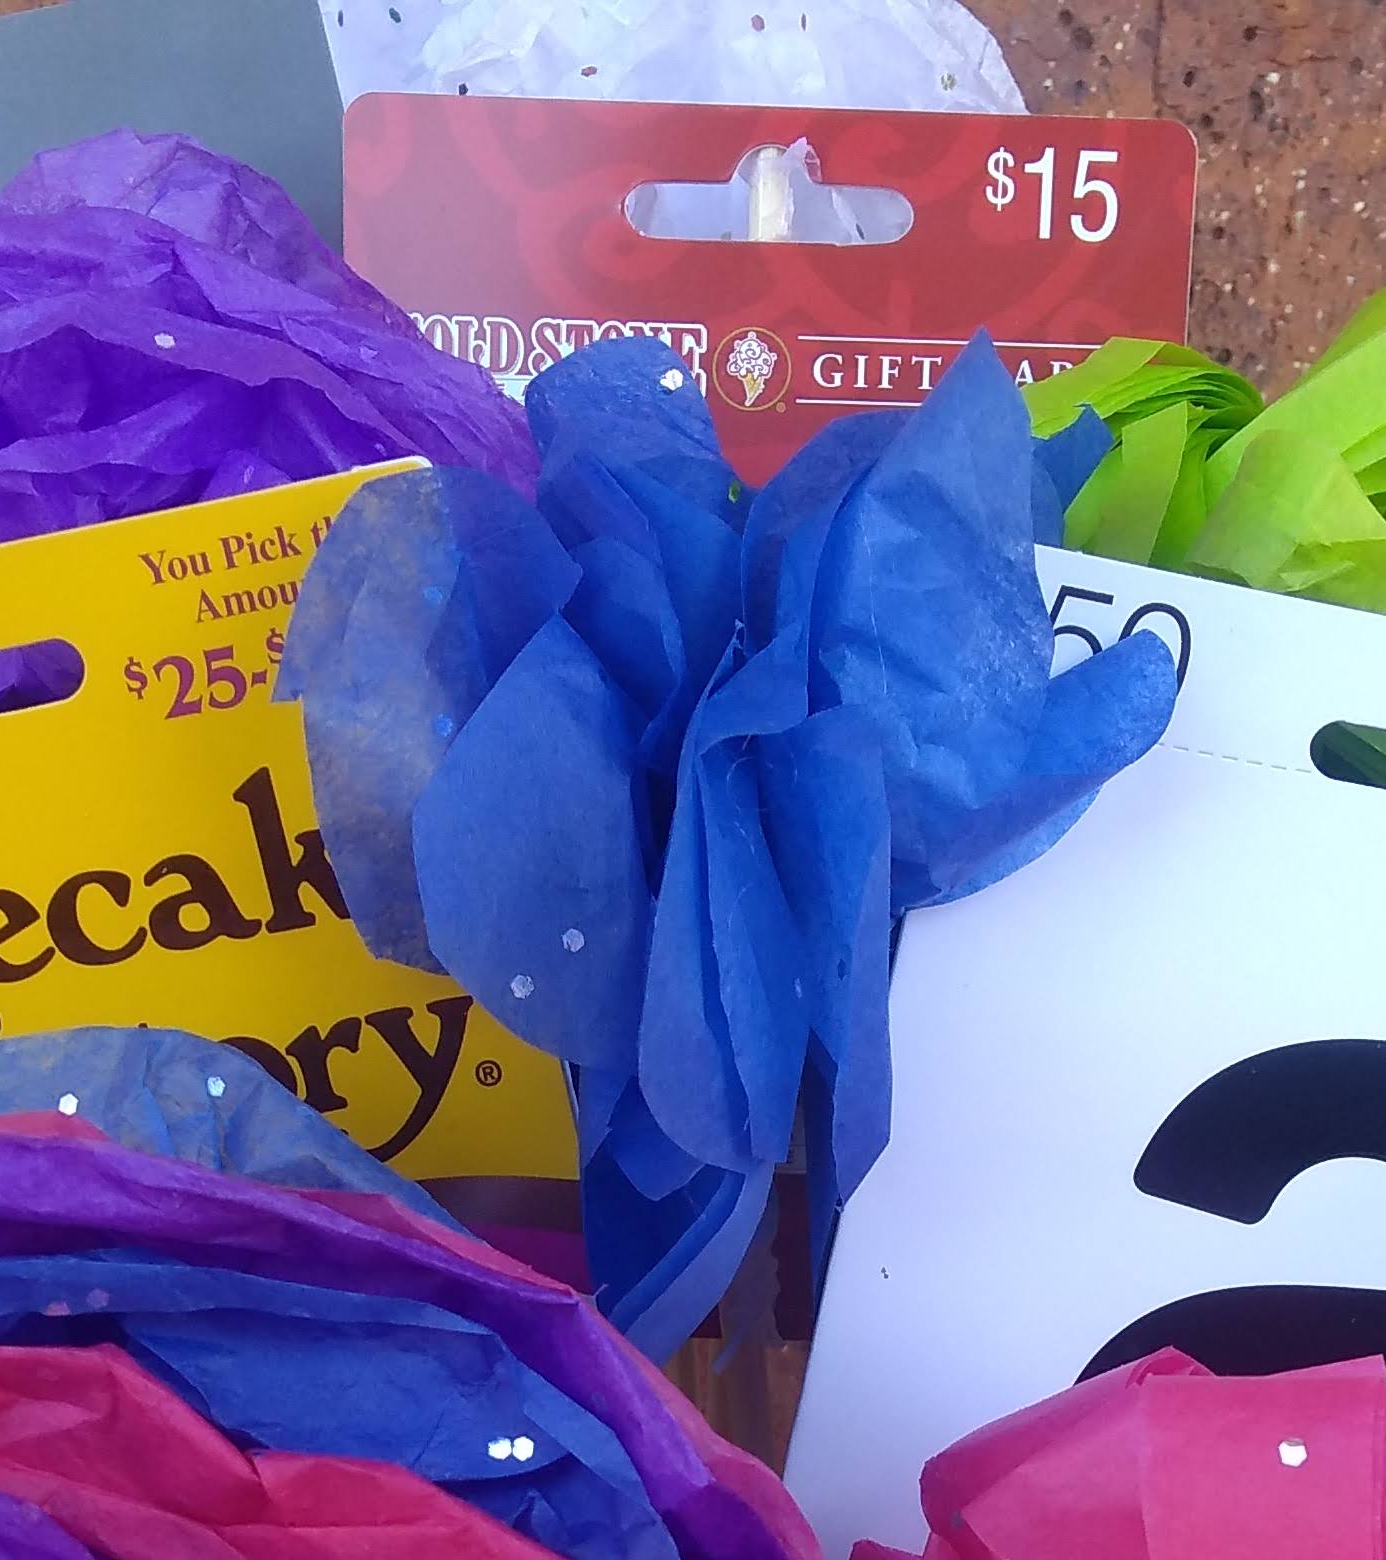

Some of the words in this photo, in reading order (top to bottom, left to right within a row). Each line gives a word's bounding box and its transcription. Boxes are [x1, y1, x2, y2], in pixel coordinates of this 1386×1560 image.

[984, 146, 1120, 243] $15
[410, 314, 525, 376] OLD
[813, 352, 944, 392] GIFT
[139, 549, 212, 586] You
[219, 526, 302, 570] Pick
[196, 577, 303, 624] Amou
